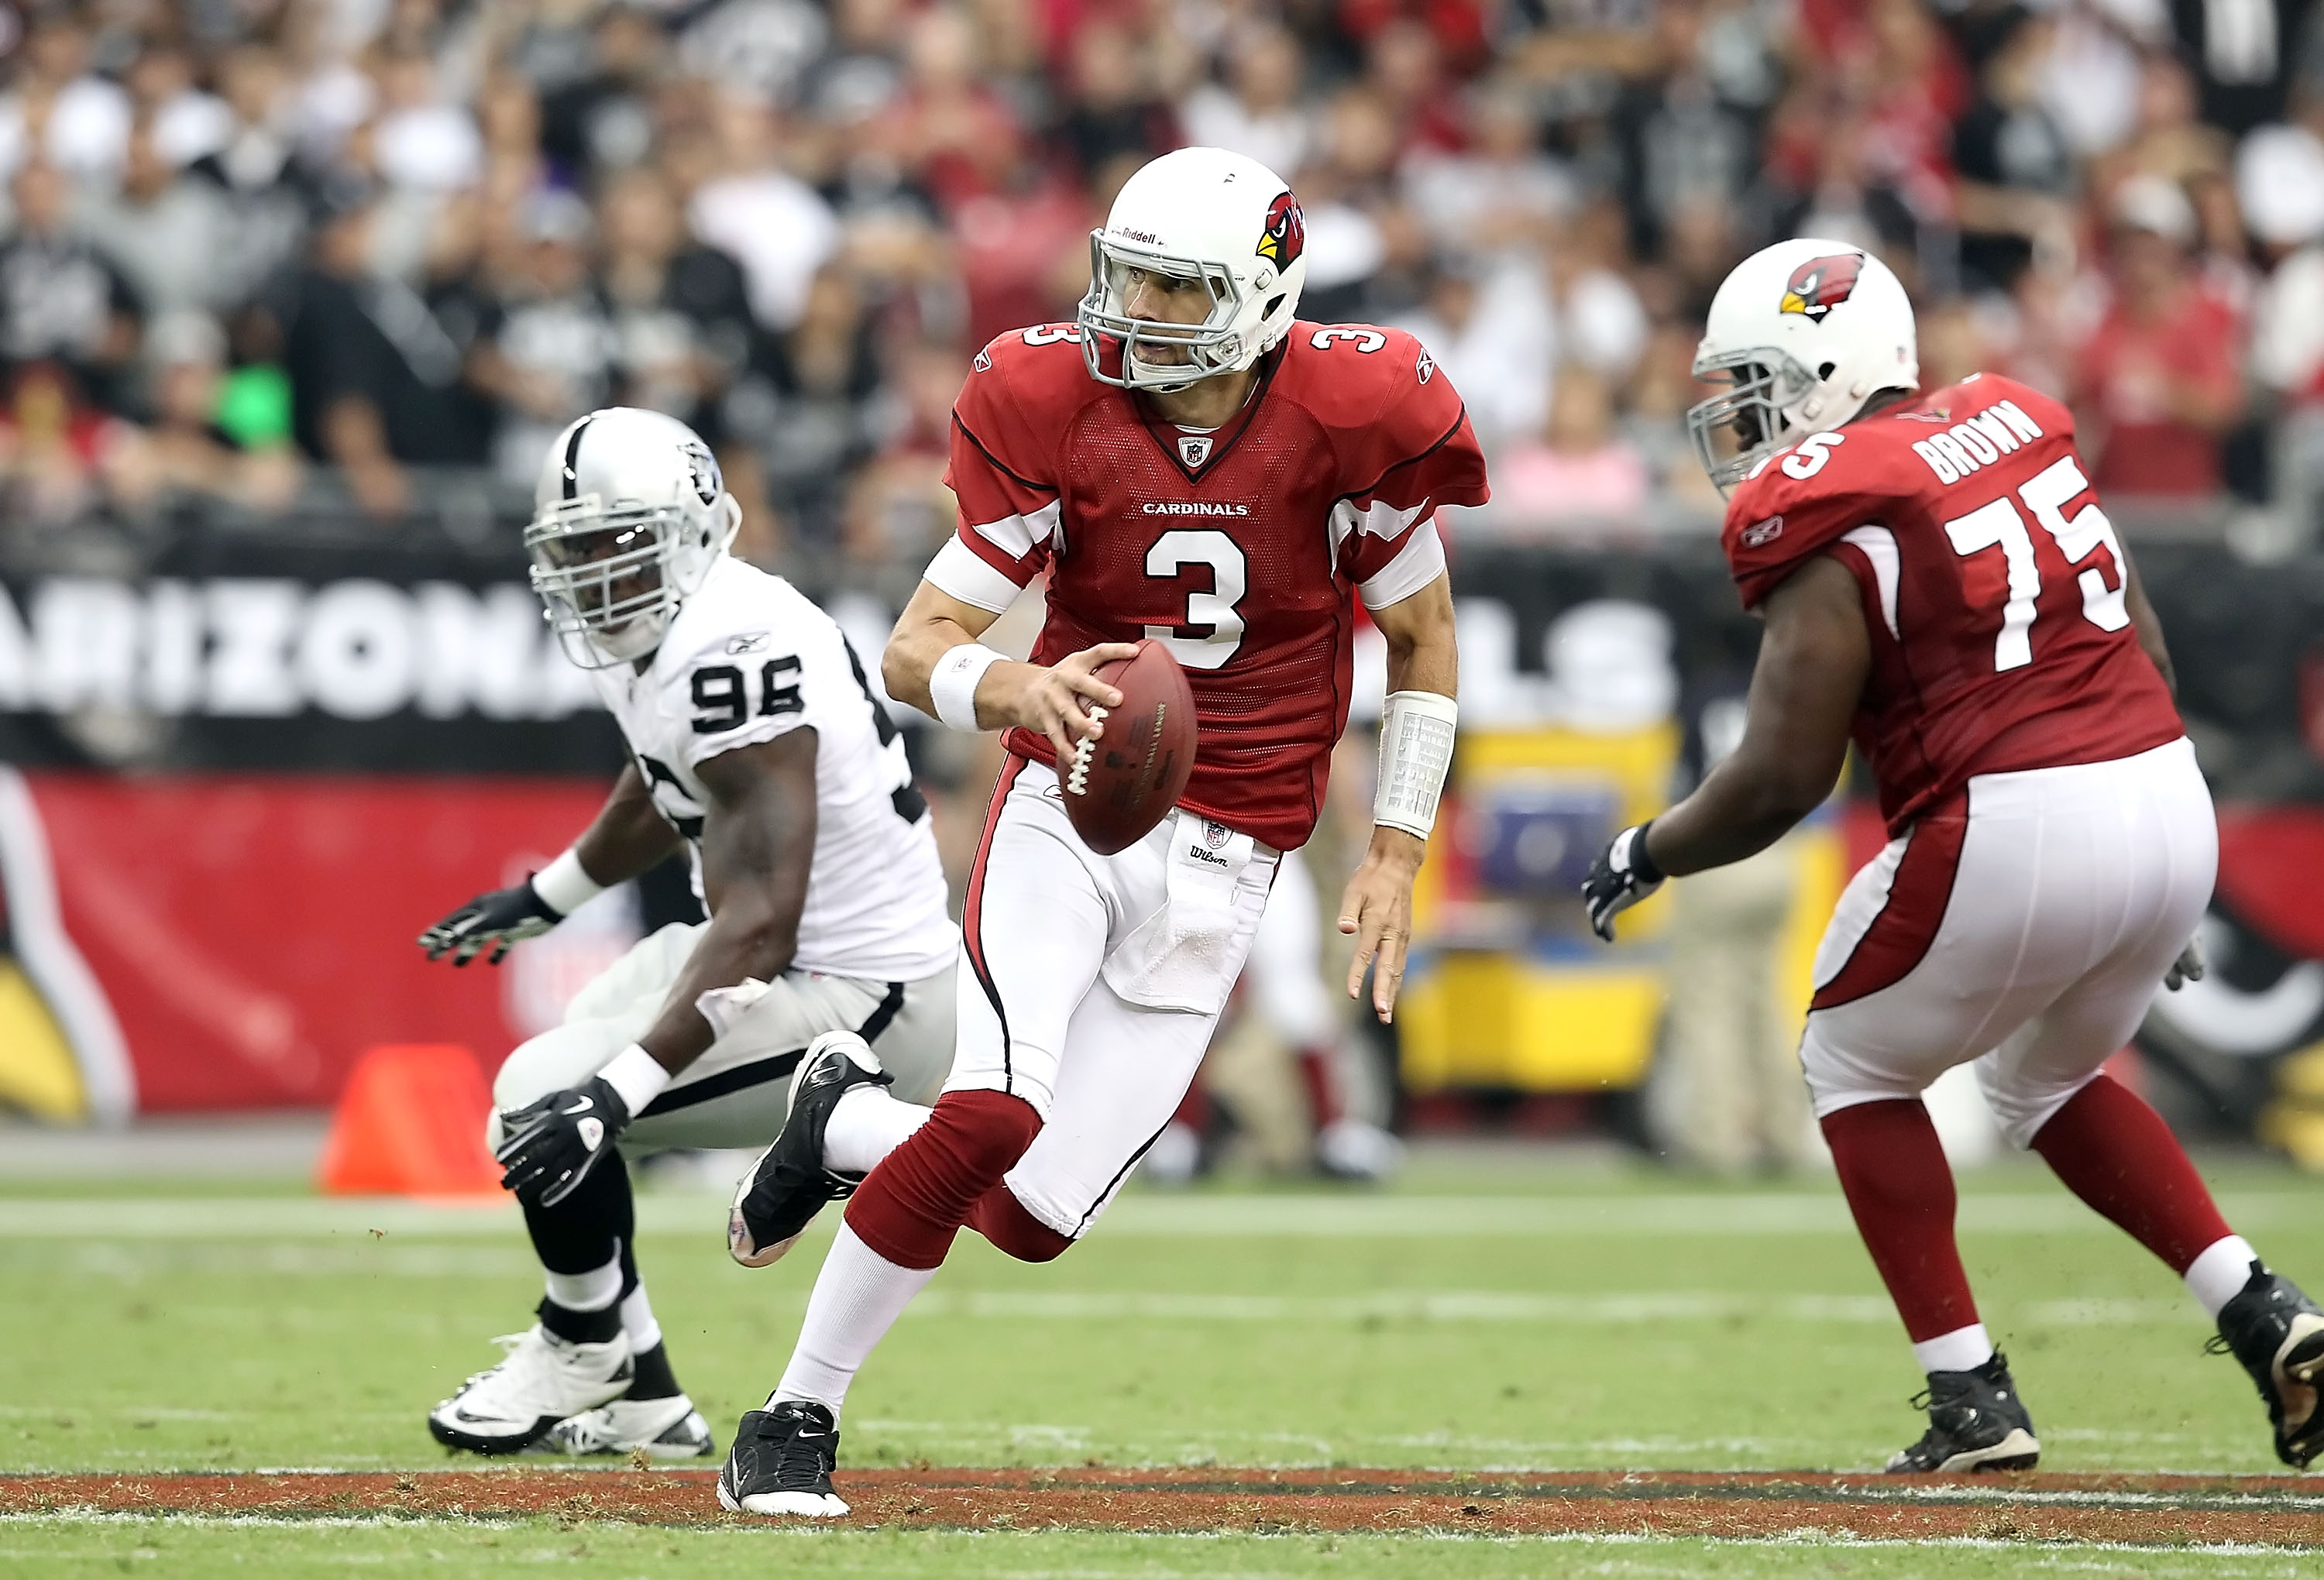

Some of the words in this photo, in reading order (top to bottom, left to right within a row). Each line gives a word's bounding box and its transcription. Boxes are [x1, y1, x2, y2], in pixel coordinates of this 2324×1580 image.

[1122, 227, 1156, 244] Riddell
[1022, 324, 1092, 347] 3
[1309, 328, 1387, 354] 3
[1911, 399, 2044, 486] BROWN
[1143, 503, 1249, 517] CARDINALS
[1943, 454, 2131, 673] 75
[1145, 529, 1248, 670] 3
[690, 654, 806, 733] 96
[1208, 830, 1222, 843] NFL
[1190, 845, 1229, 867] Wilson
